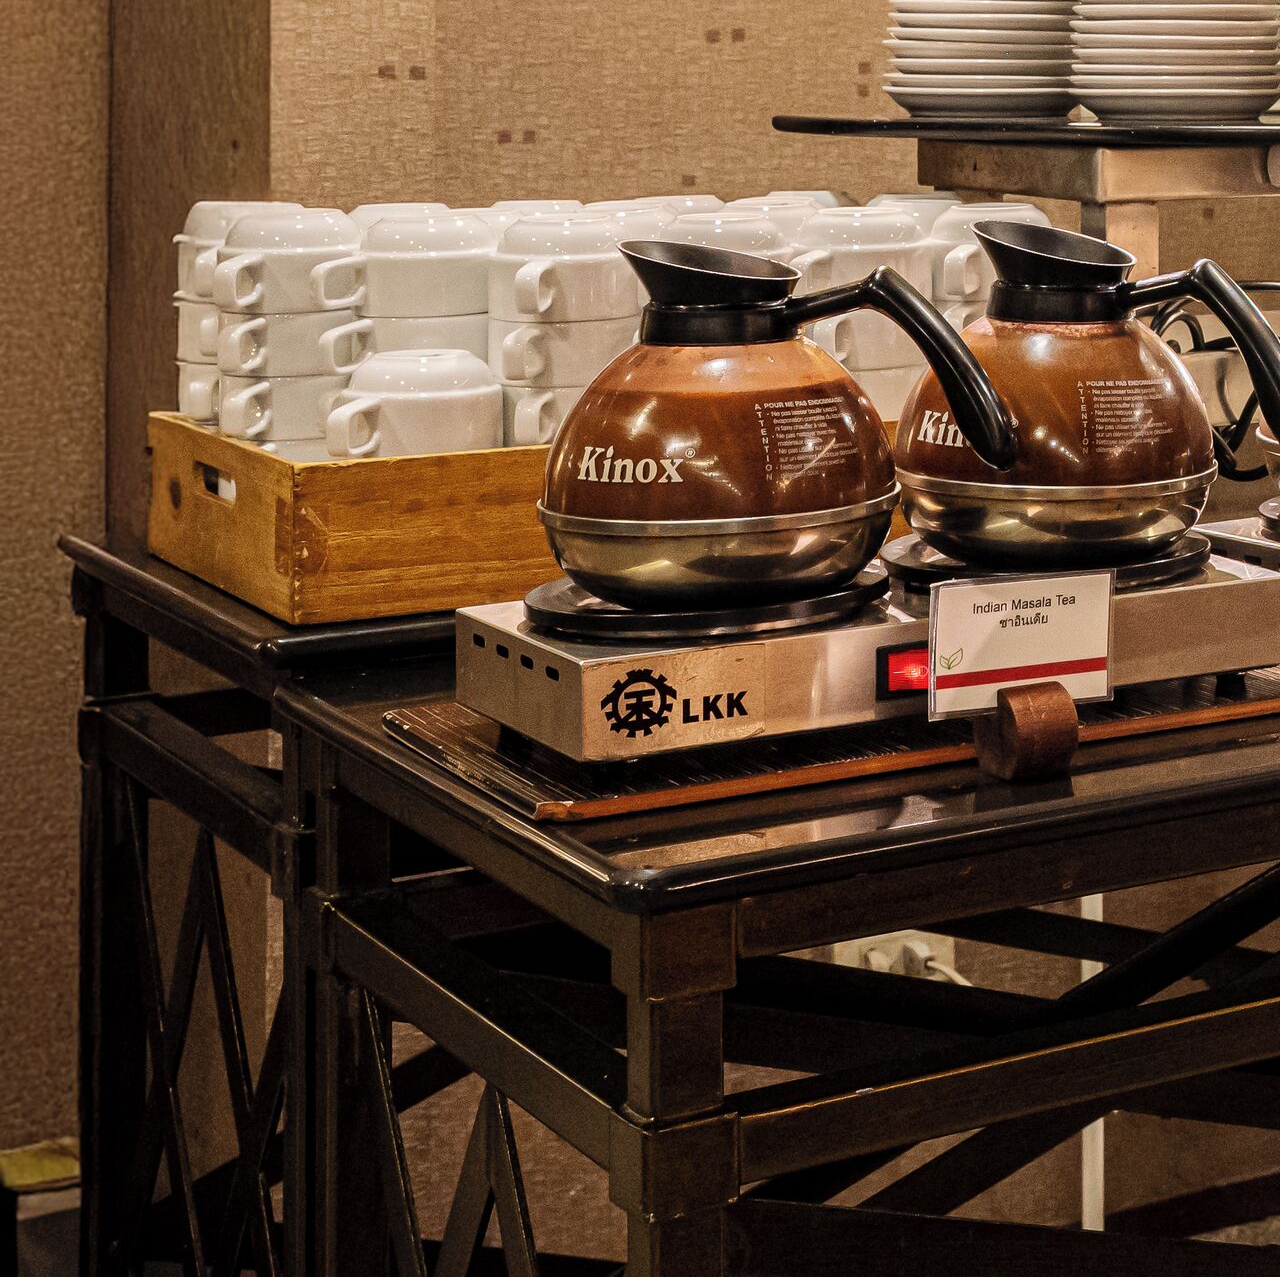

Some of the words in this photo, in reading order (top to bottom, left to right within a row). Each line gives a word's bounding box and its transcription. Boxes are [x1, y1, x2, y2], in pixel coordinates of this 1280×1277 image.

[764, 401, 784, 409] POUR
[784, 400, 794, 408] NE
[754, 403, 773, 481] ATTENTION
[972, 601, 1008, 614] Indian
[1011, 596, 1052, 611] Masala
[1055, 594, 1077, 606] Tea
[682, 690, 749, 724] LKK
